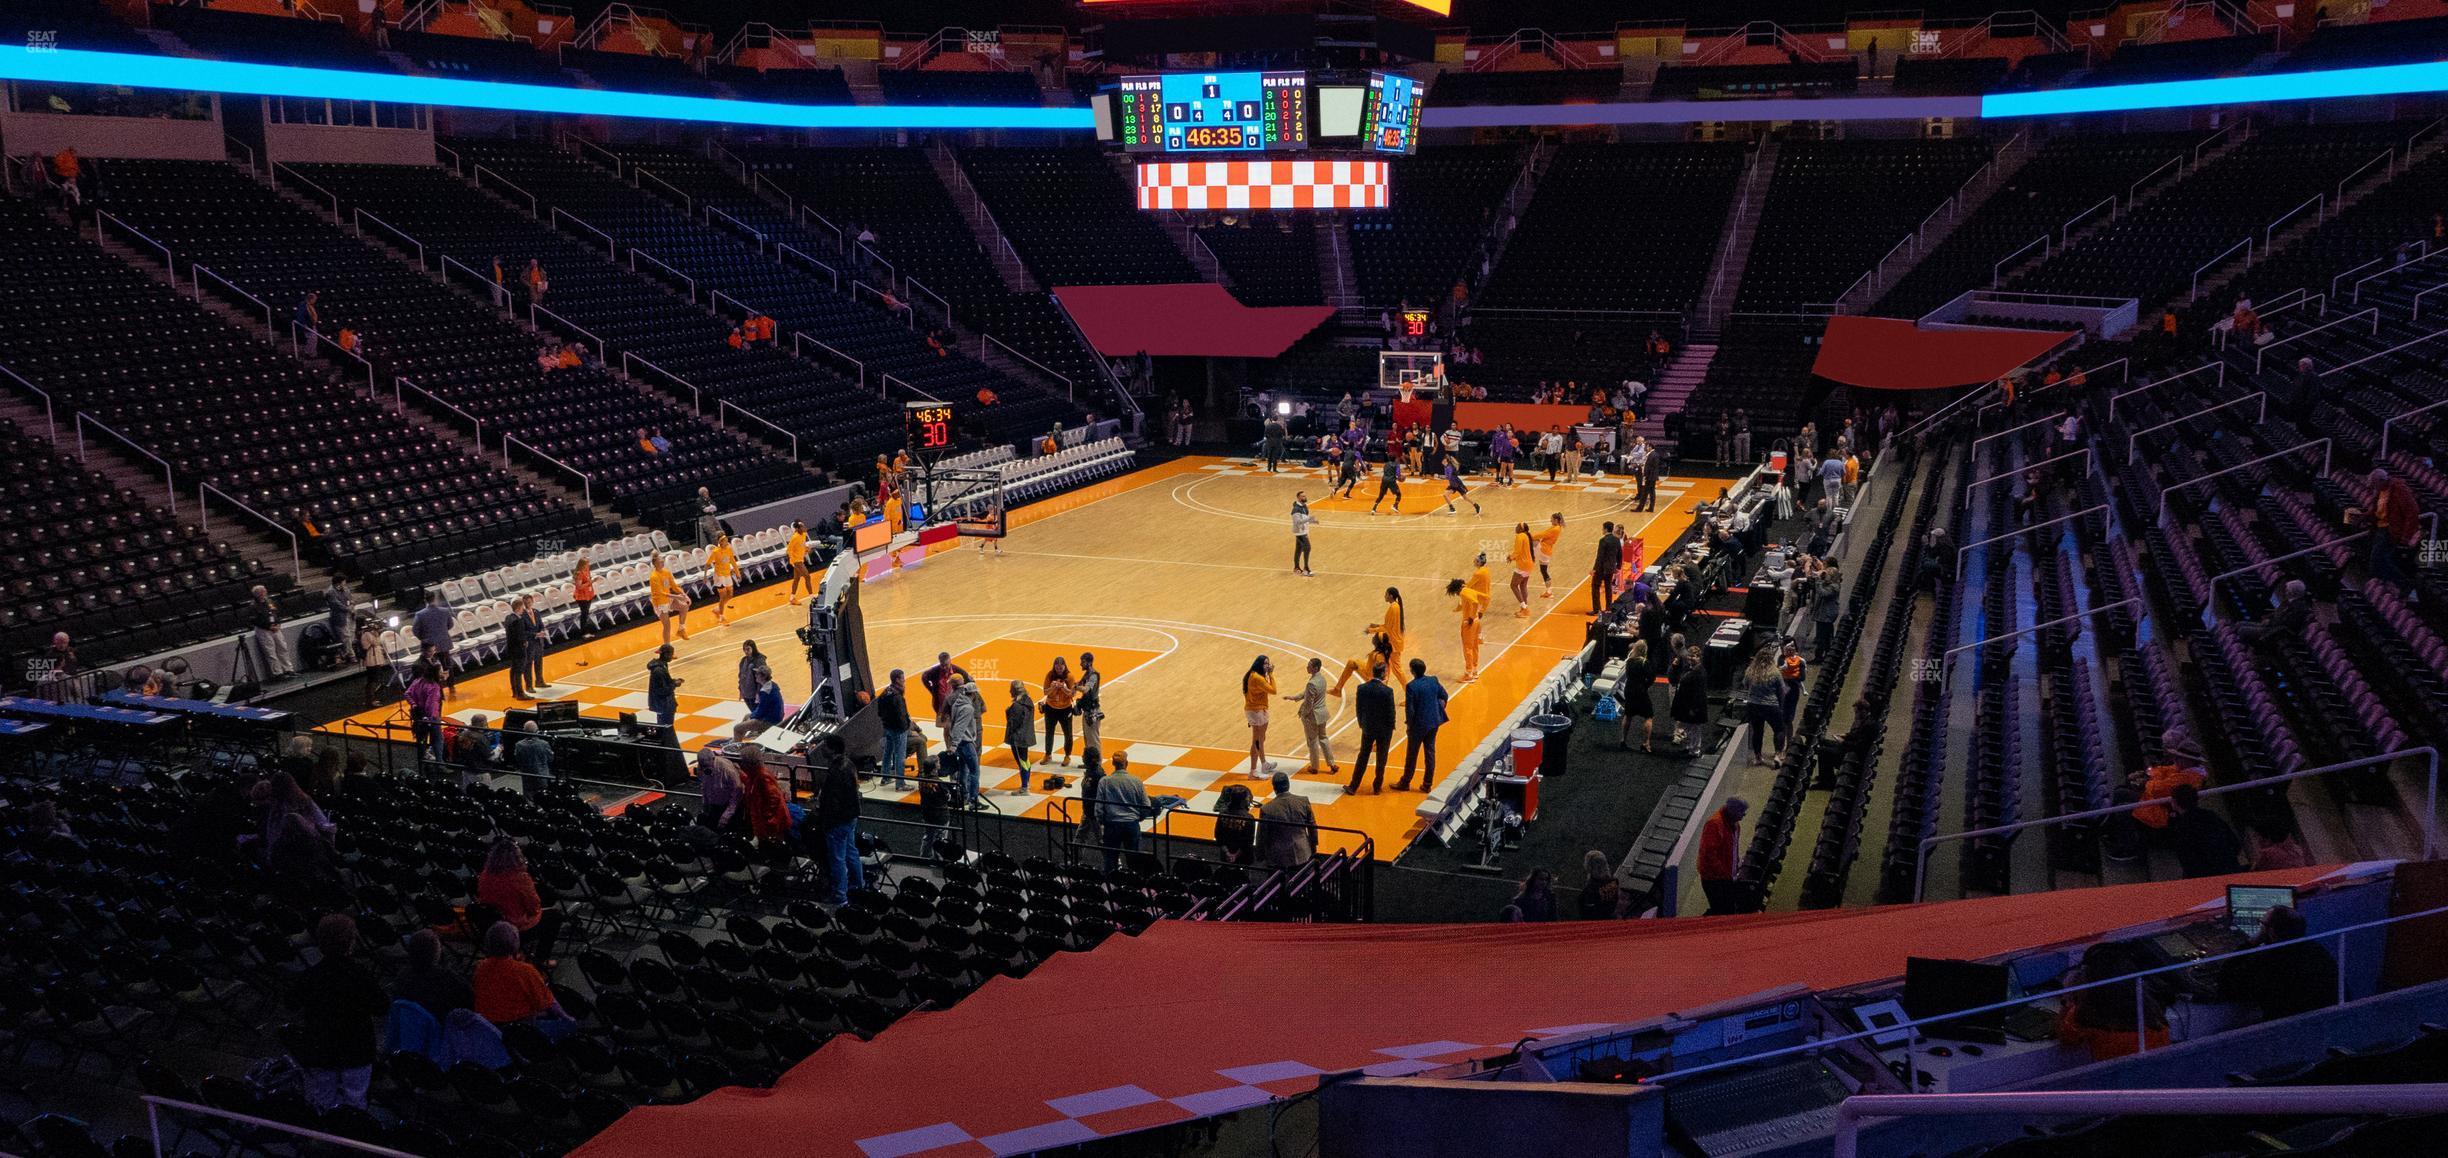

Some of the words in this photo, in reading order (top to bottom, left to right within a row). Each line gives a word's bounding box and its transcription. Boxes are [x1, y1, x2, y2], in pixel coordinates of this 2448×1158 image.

[1209, 86, 1215, 98] 1
[1267, 91, 1272, 99] 3
[1282, 90, 1288, 98] 0
[1295, 90, 1301, 98] 0
[1123, 95, 1134, 103] 00
[1152, 94, 1158, 102] 9
[1151, 104, 1161, 112] 17
[1265, 102, 1275, 110] 11
[1283, 100, 1288, 108] 0
[1295, 101, 1301, 109] 7
[1174, 106, 1181, 120] 0
[1195, 111, 1202, 121] 4
[1224, 111, 1231, 120] 4
[1244, 105, 1251, 118] 0
[1265, 112, 1276, 120] 20
[1283, 111, 1289, 120] 2
[1296, 111, 1301, 120] 7
[1152, 125, 1162, 133] 10
[1265, 123, 1276, 131] 21
[1296, 122, 1302, 130] 2
[1141, 135, 1147, 144] 0
[1155, 135, 1161, 144] 0
[1187, 128, 1241, 146] 46:35
[1249, 136, 1256, 146] 0
[1284, 132, 1290, 141] 0
[1296, 132, 1302, 141] 0
[1172, 138, 1179, 147] 0
[1408, 322, 1423, 335] 30
[916, 408, 951, 422] 46:34
[923, 423, 947, 446] 30
